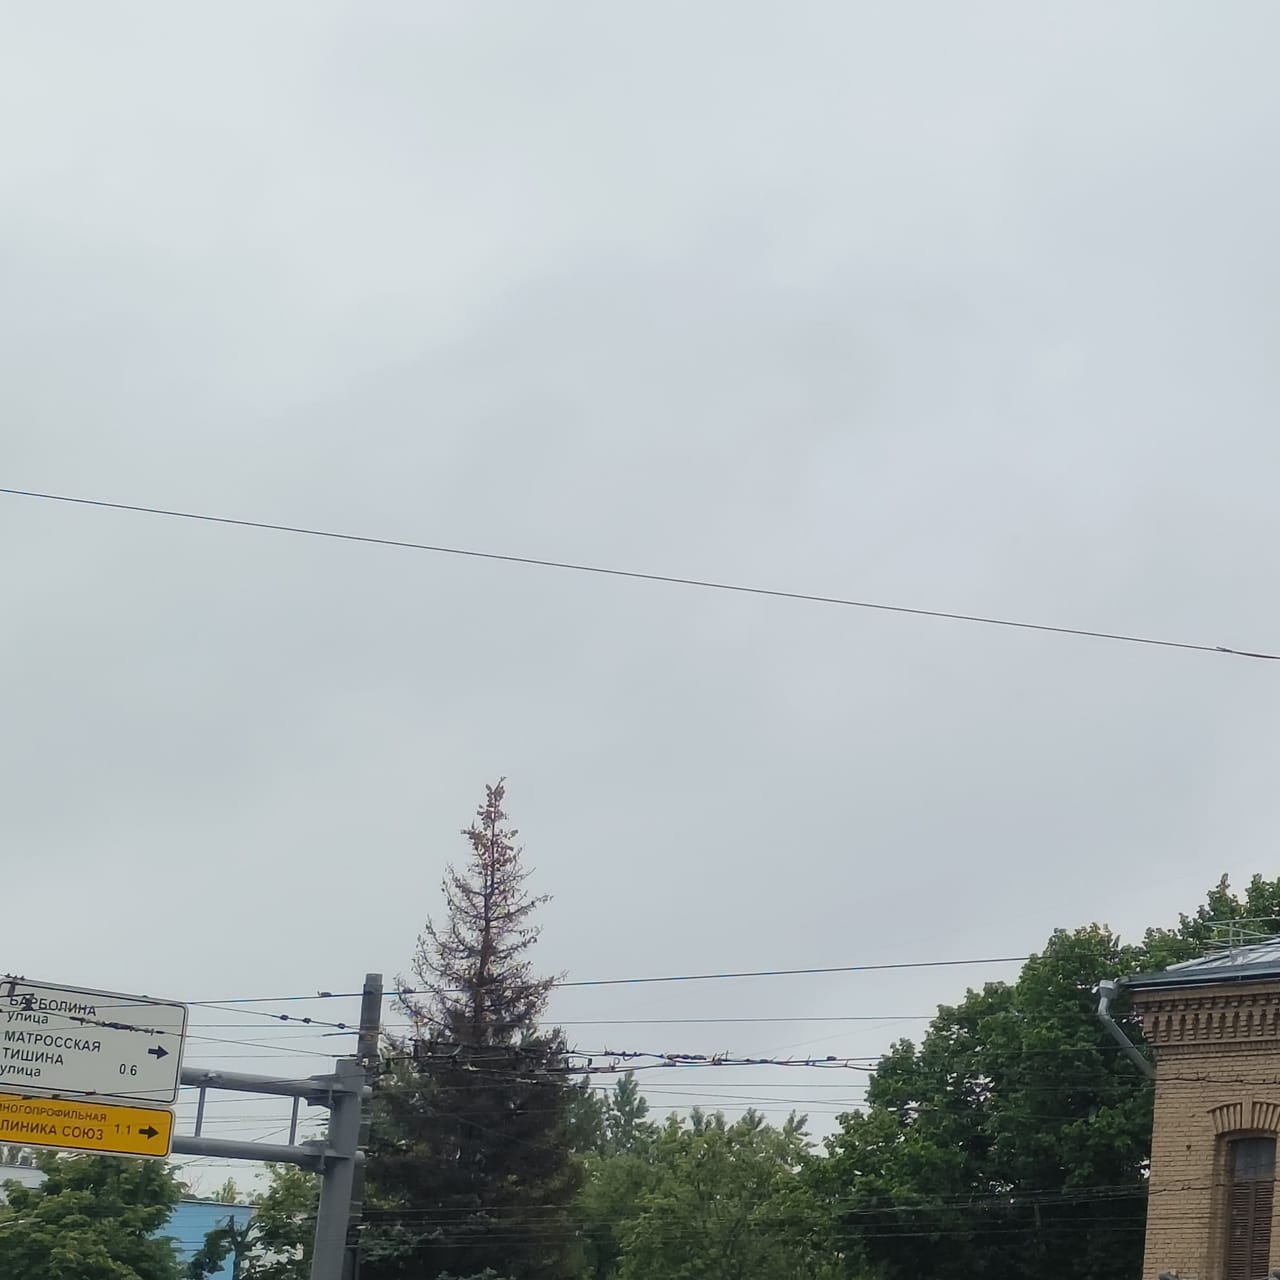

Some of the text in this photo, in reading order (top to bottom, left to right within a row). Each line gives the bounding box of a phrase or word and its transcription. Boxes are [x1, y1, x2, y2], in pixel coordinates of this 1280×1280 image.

[8, 1011, 48, 1025] улица
[4, 1030, 101, 1052] МАТРОССКАЯ
[3, 1047, 64, 1065] ТИШИНА
[0, 1065, 41, 1078] улица
[0, 1119, 57, 1136] ЛИНИКА
[62, 1125, 104, 1140] СОЮЗ
